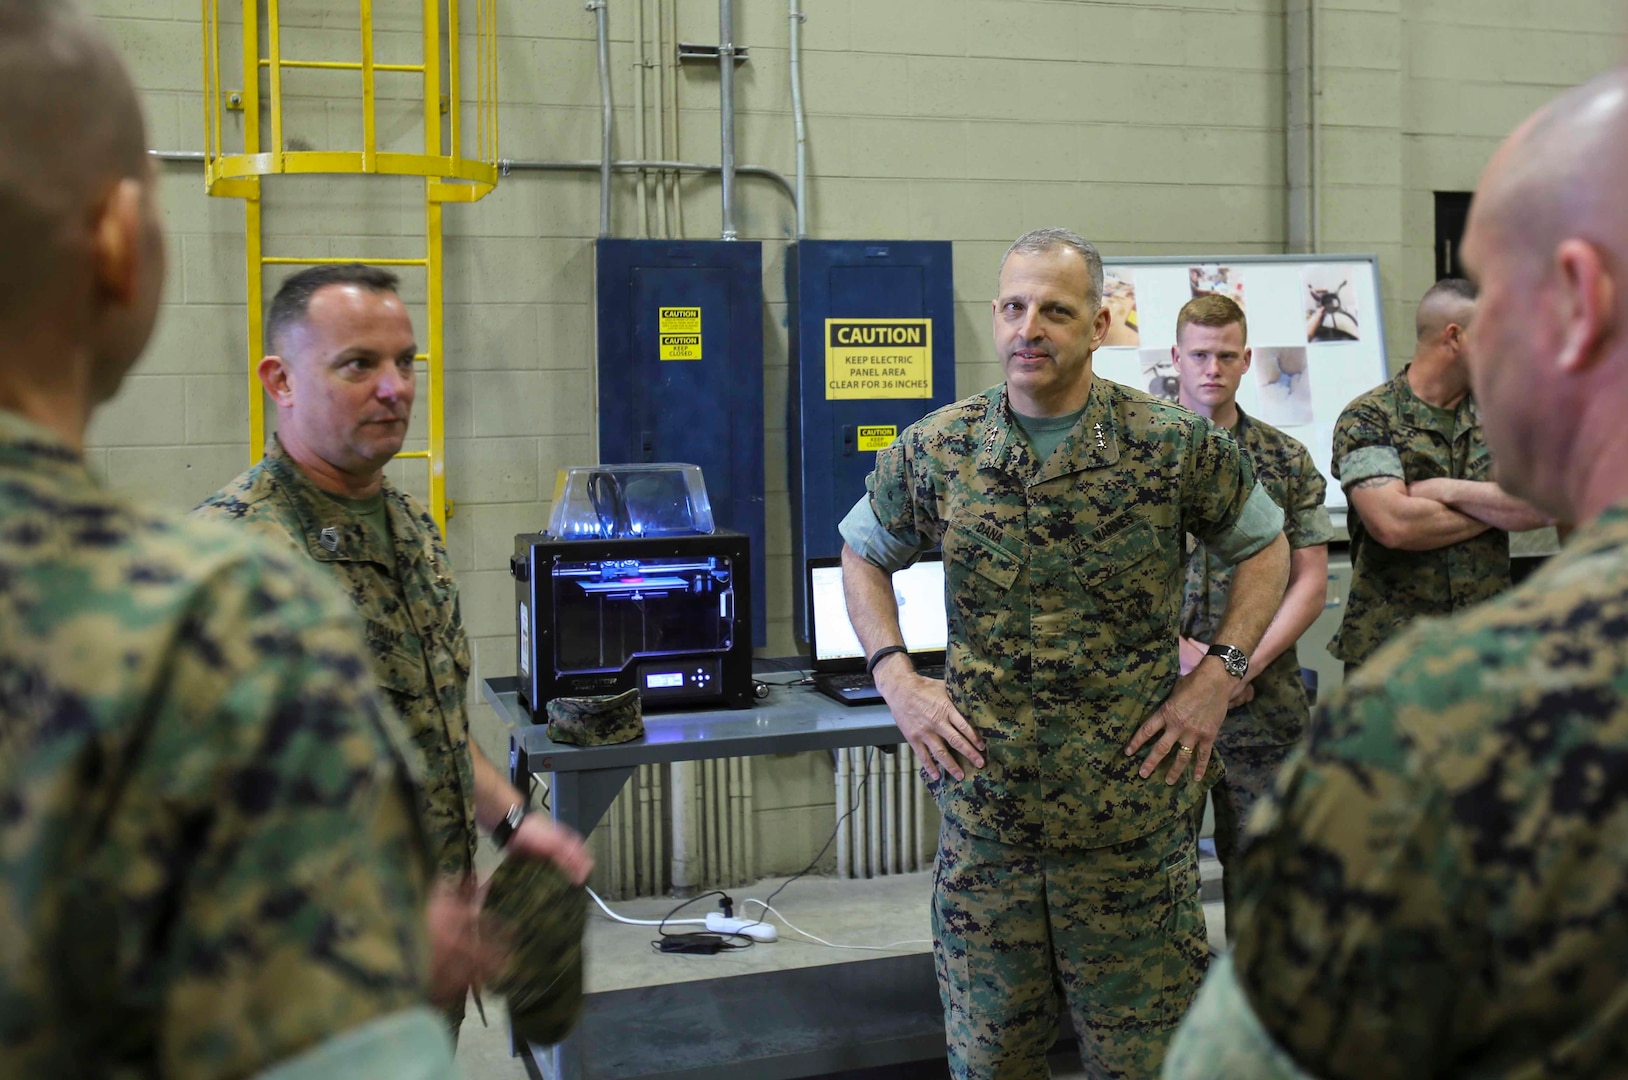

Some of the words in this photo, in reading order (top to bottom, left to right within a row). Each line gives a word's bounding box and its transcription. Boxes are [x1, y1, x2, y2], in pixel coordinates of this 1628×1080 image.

[837, 327, 921, 344] CAUTION
[845, 356, 868, 364] KEEP
[870, 356, 912, 364] ELECTRIC
[882, 368, 906, 376] AREA
[829, 381, 859, 389] CLEAR
[861, 381, 880, 389] FOR
[895, 380, 928, 388] INCHES
[976, 521, 1003, 543] DANA
[1071, 539, 1092, 555] U.S.
[1092, 515, 1133, 543] MARINES
